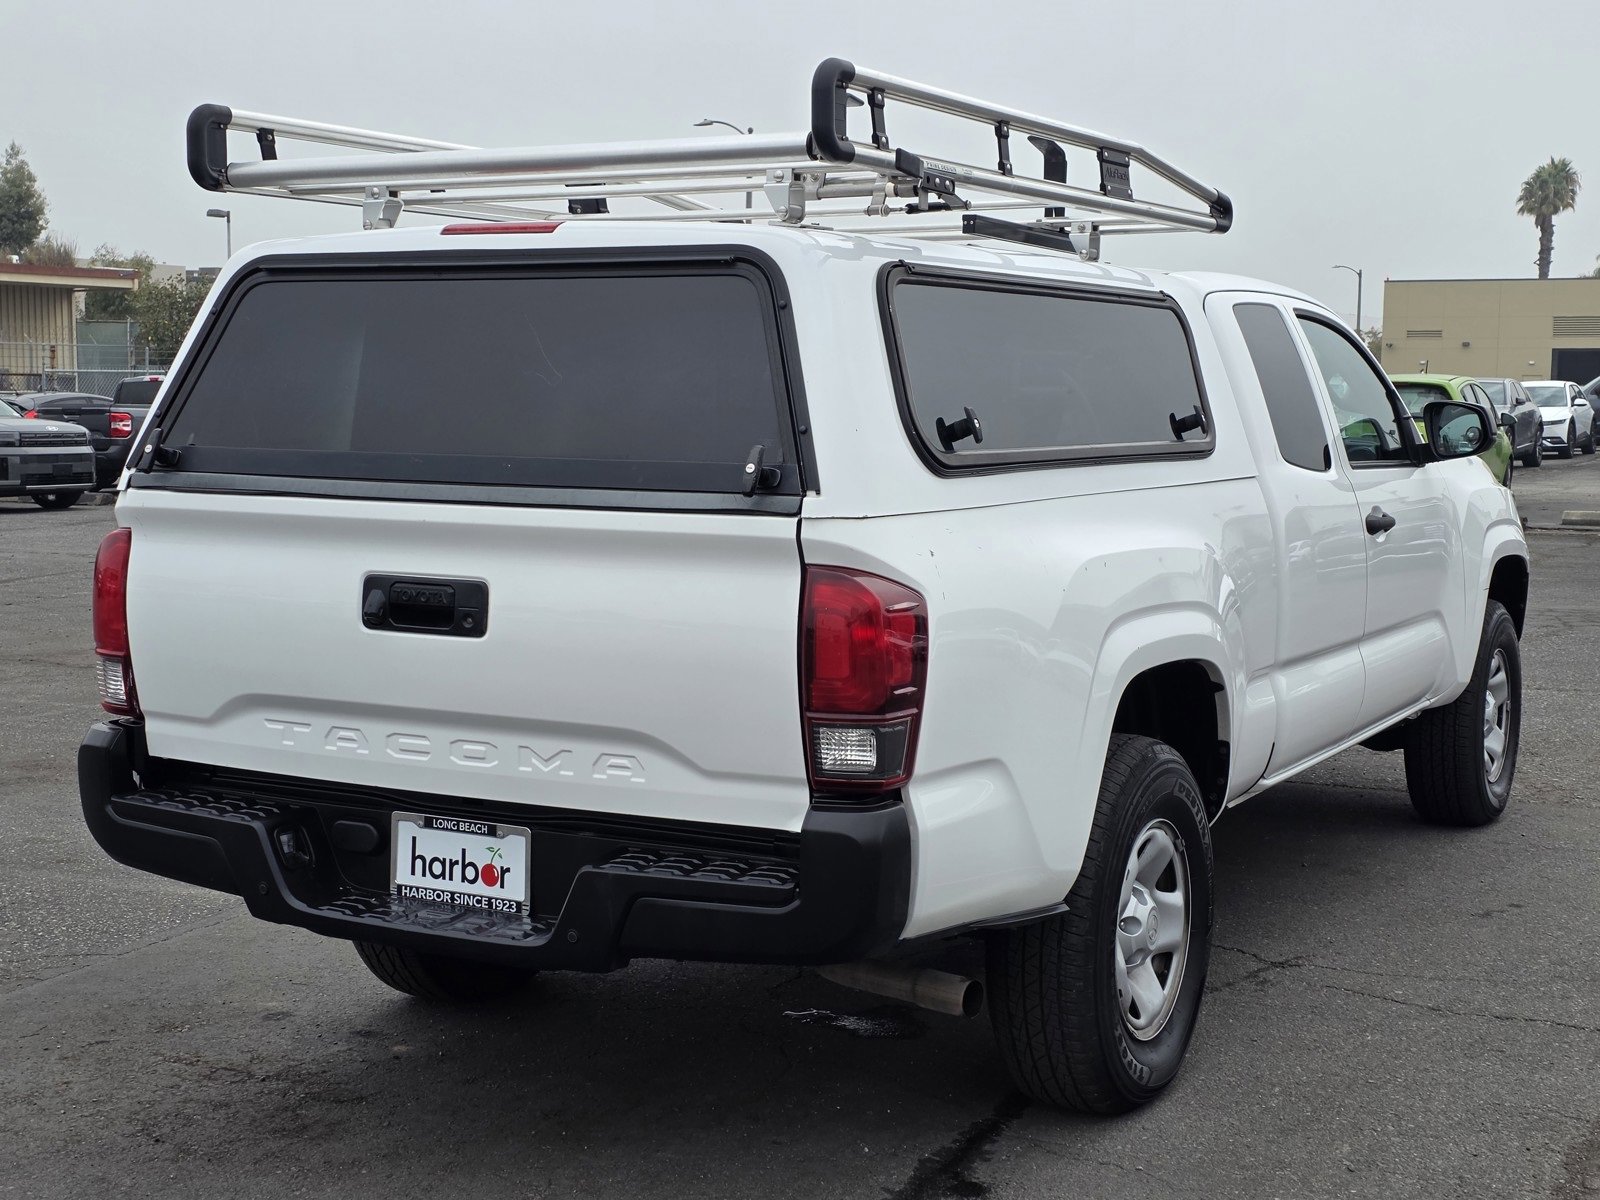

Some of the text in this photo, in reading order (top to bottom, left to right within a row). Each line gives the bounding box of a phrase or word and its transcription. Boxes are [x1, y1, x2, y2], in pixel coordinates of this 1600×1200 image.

[393, 588, 448, 605] TOYOTA
[264, 718, 645, 783] TACOMA
[433, 818, 488, 834] LONG BEACH
[411, 835, 511, 889] harbor
[401, 886, 517, 913] HARBOR SINCE 1923
